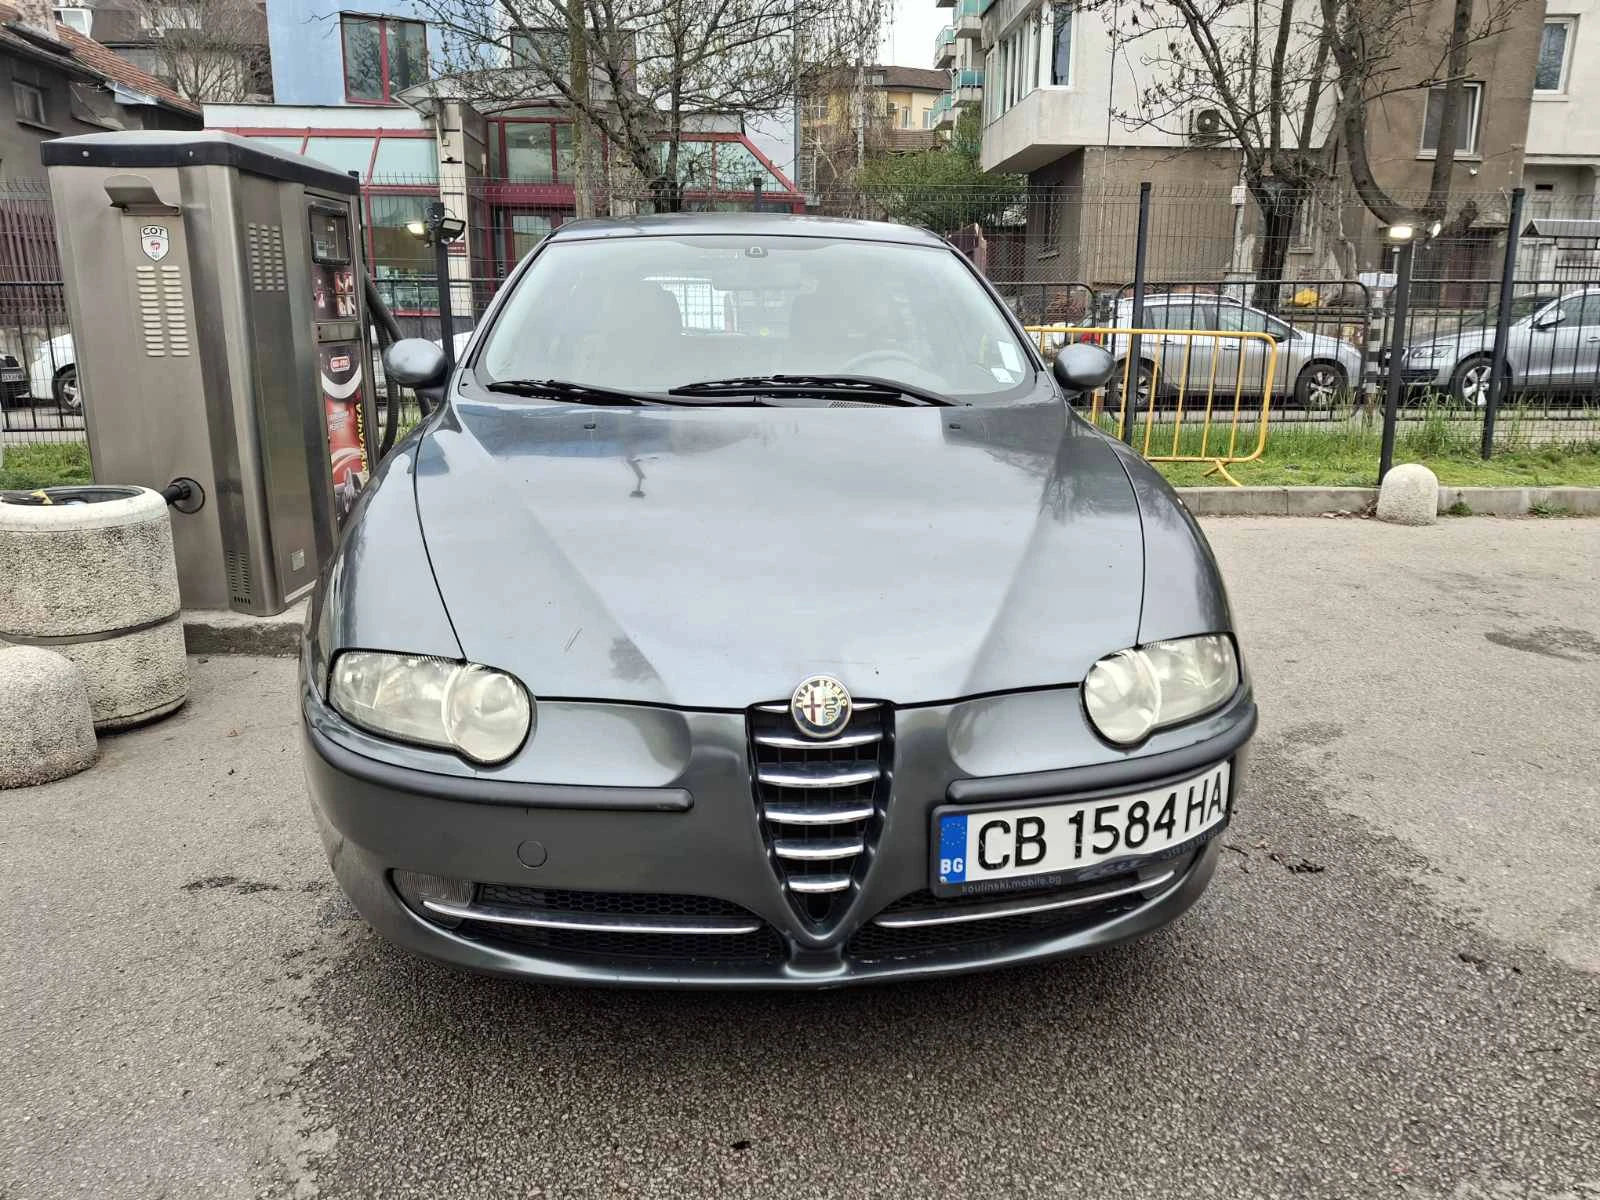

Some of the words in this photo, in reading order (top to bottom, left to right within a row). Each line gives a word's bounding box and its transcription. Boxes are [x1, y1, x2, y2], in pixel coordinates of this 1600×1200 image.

[795, 684, 813, 708] ALFA
[819, 680, 848, 707] ROMEO
[978, 816, 1047, 870] CB
[1068, 792, 1177, 859] 1584
[1185, 772, 1222, 832] HA
[940, 857, 964, 875] BG
